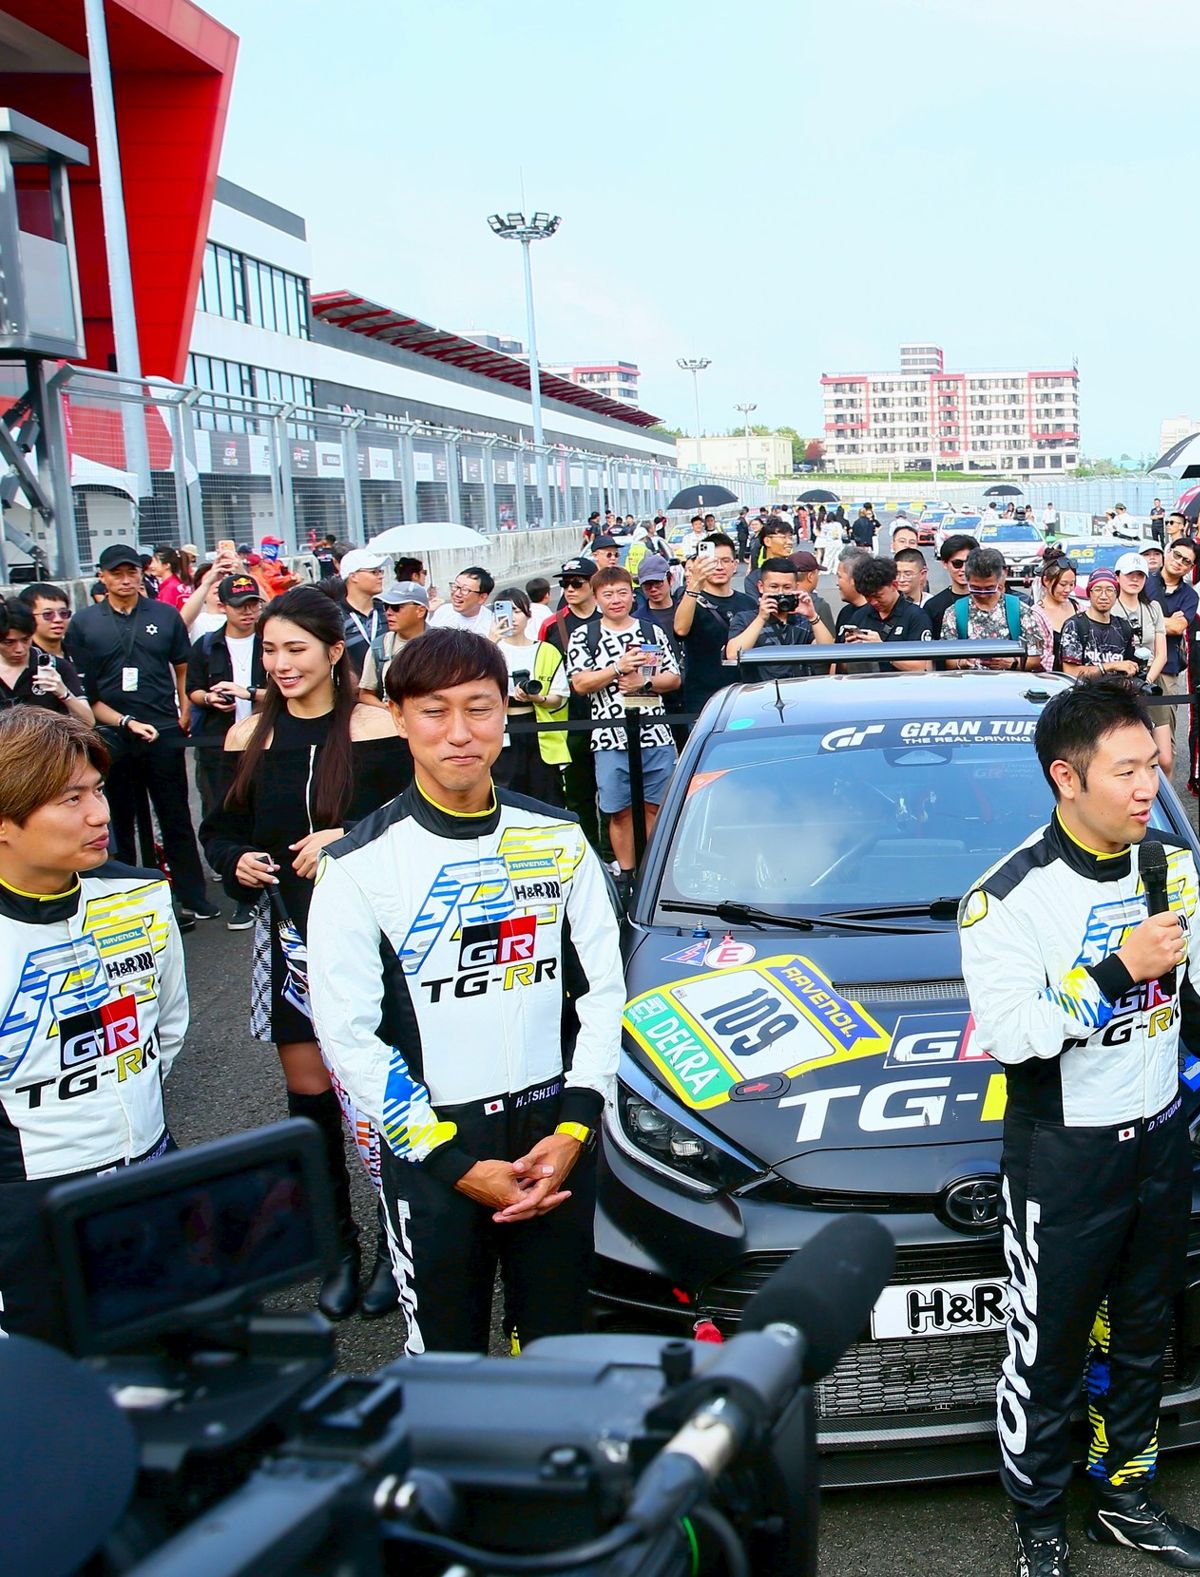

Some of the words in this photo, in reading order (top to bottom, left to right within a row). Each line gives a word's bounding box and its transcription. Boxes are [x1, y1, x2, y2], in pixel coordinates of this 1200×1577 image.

[900, 720, 982, 738] GRAN
[903, 737, 931, 745] THE
[934, 736, 972, 744] REAL
[974, 735, 1034, 743] DRIVING
[511, 859, 551, 871] RAVENOL
[514, 885, 545, 901] H&R
[102, 931, 142, 946] RAVENOL
[461, 933, 535, 970] GR
[107, 957, 137, 980] H&R
[421, 957, 558, 1003] TG-RR
[701, 987, 800, 1057] 109
[780, 966, 856, 1039] RAVENOL
[63, 1016, 138, 1066] GR
[645, 1015, 720, 1096] DEKRA
[15, 1040, 158, 1109] TG-RR
[907, 1284, 1006, 1332] H&R
